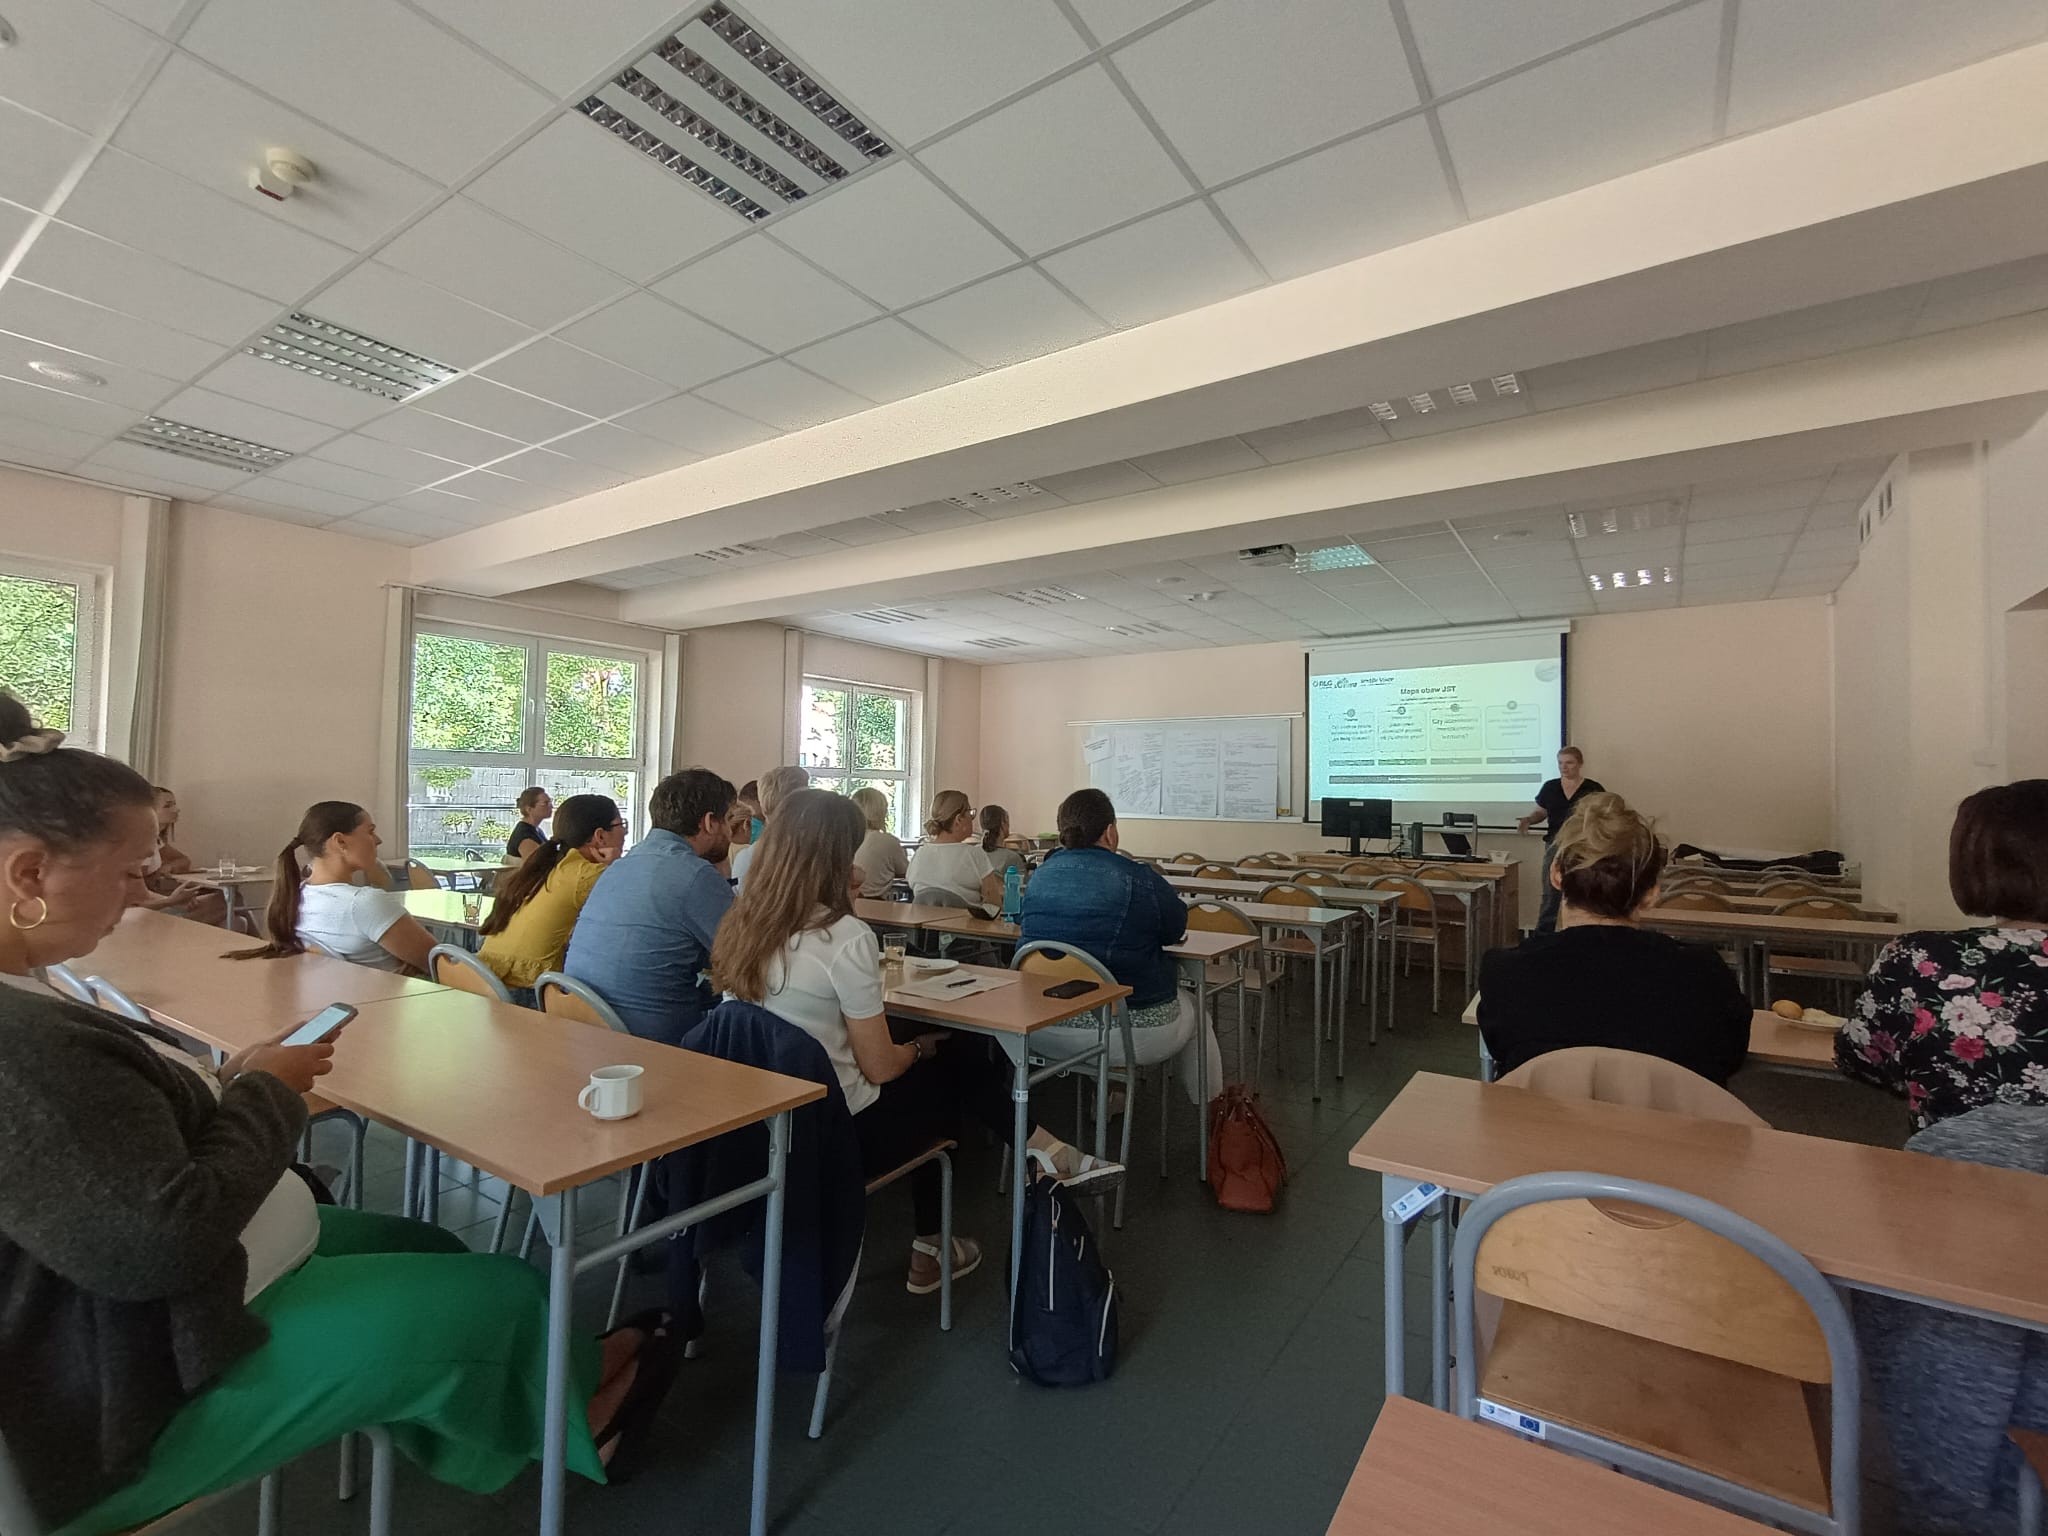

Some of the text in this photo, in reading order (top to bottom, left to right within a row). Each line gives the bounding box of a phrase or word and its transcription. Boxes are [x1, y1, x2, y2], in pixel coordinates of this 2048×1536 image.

[1400, 685, 1457, 696] Mapa obaw JST
